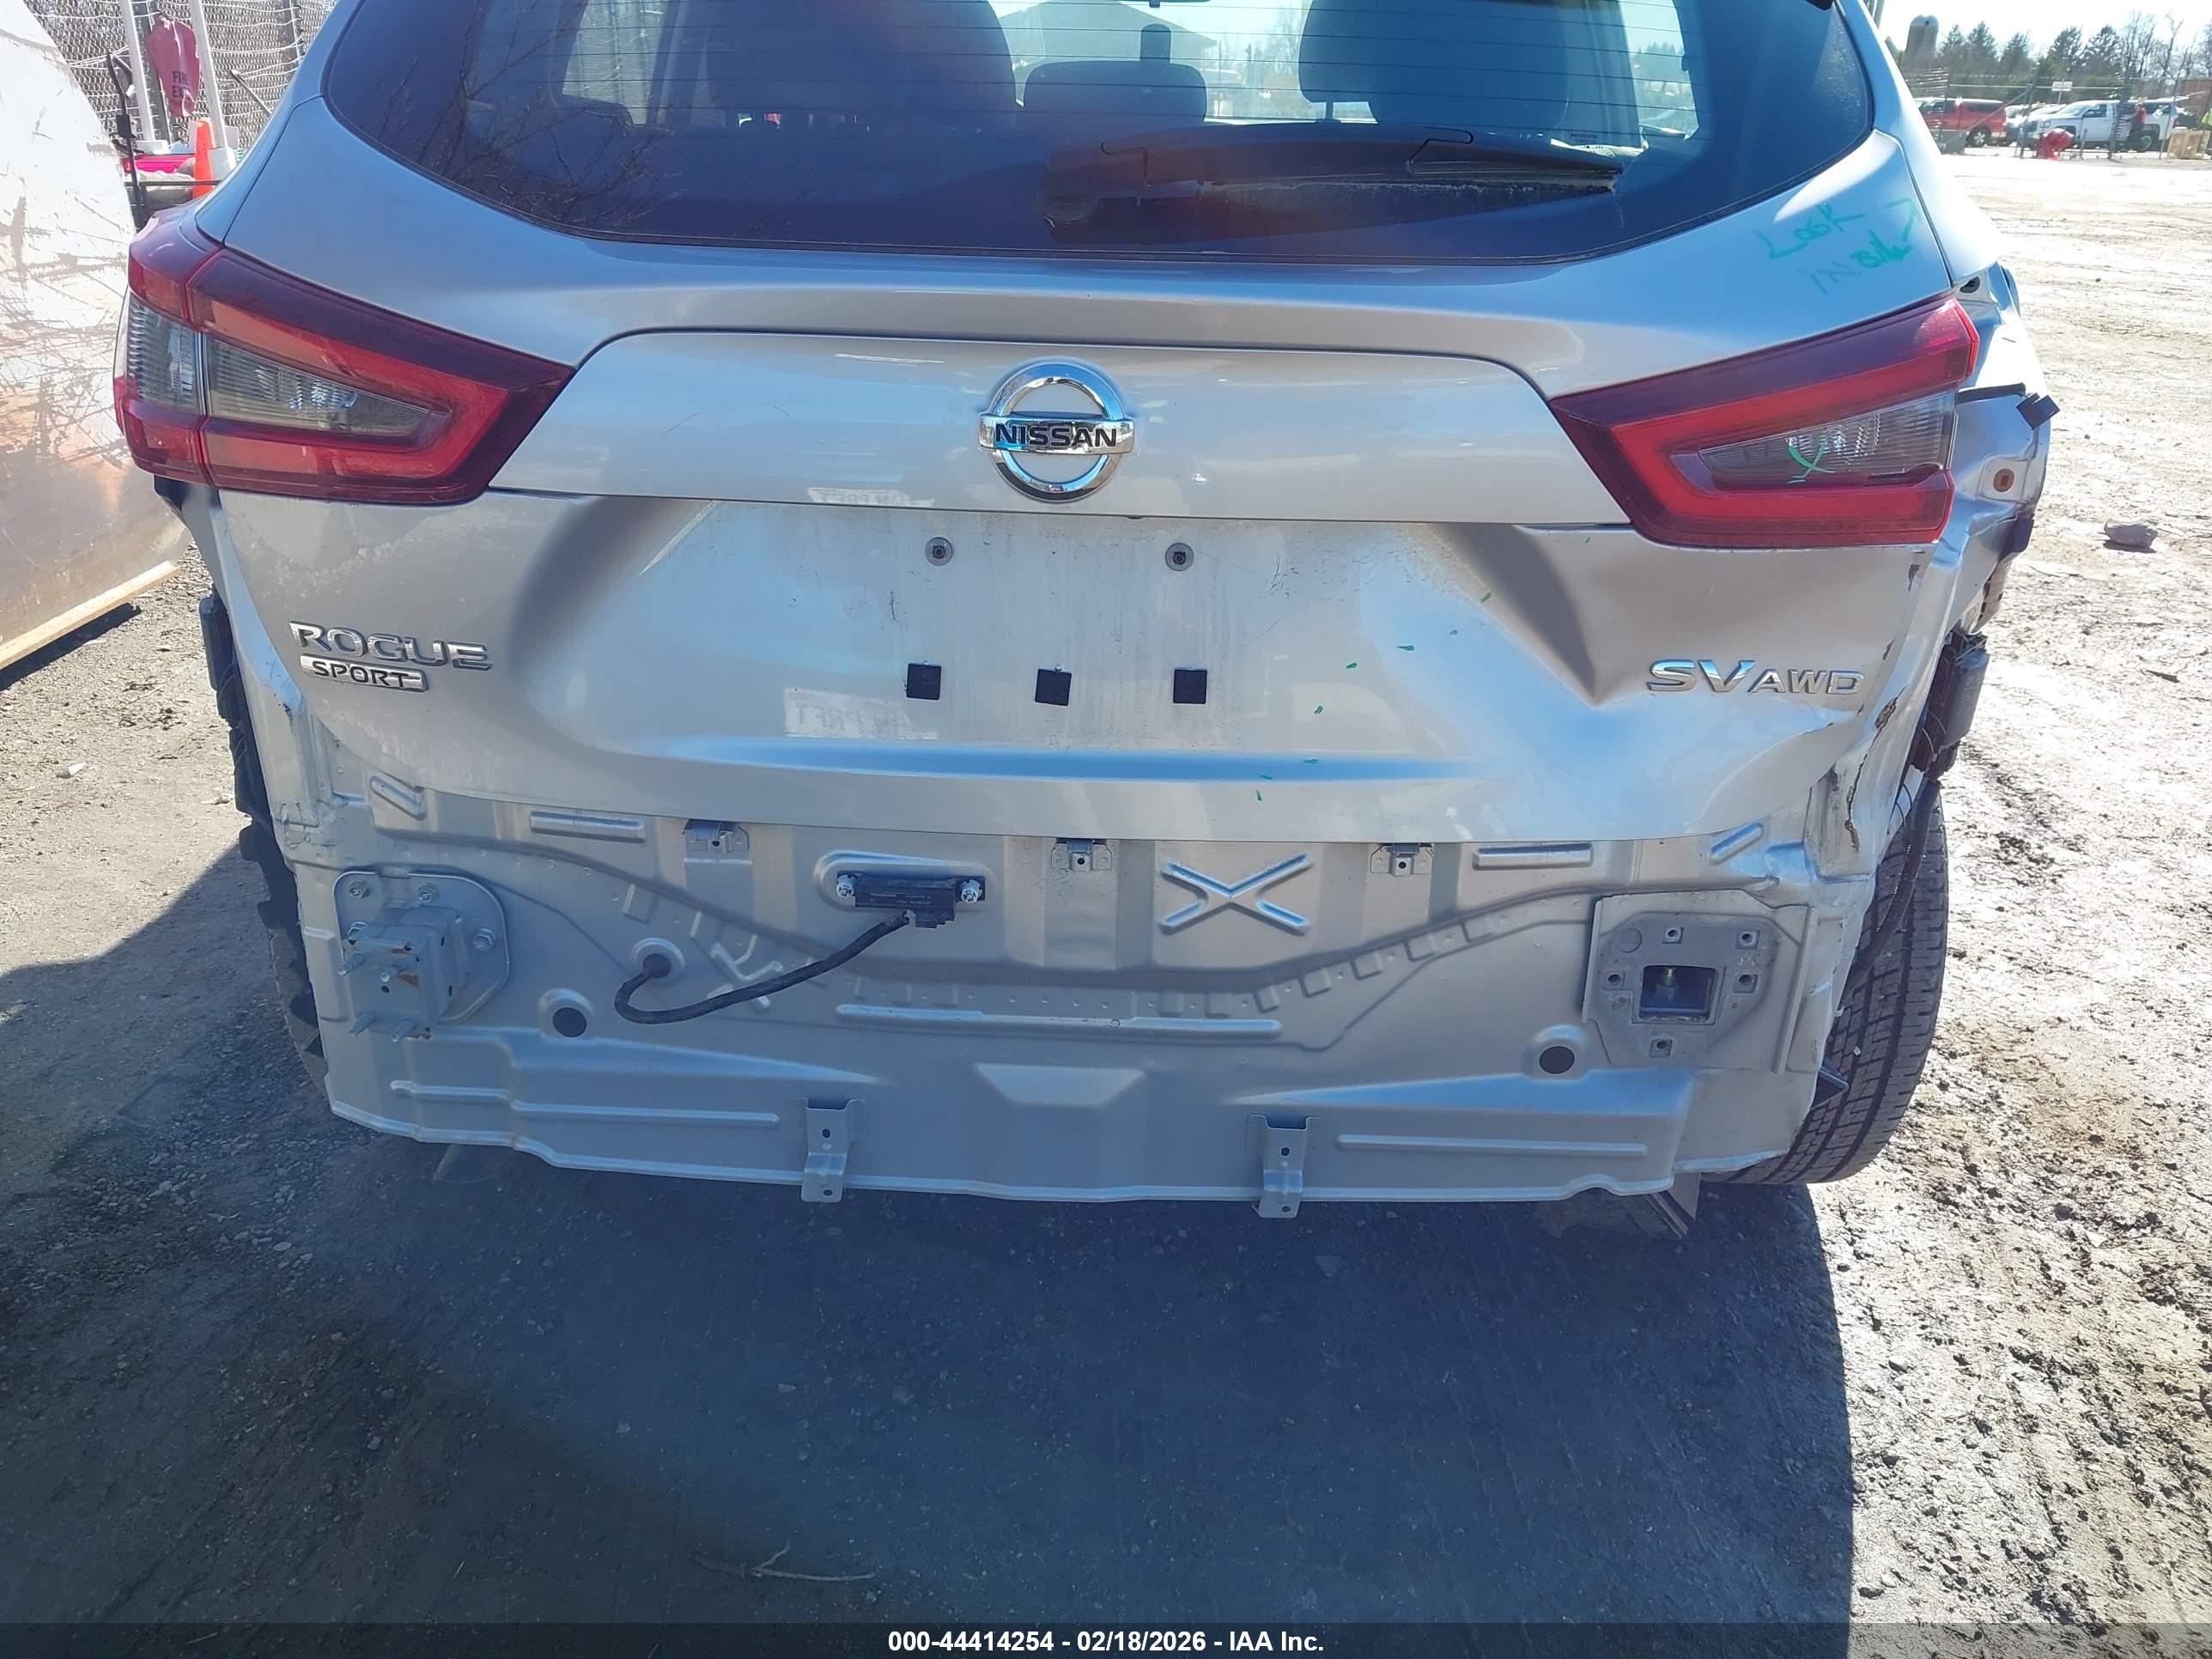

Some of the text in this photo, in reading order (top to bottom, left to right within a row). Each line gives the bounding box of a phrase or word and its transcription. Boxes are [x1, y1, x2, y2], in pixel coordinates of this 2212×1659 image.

[995, 423, 1117, 447] NISSAN
[289, 620, 492, 672] ROGUE
[312, 660, 410, 689] SPORT
[1646, 659, 1865, 696] SV AWD
